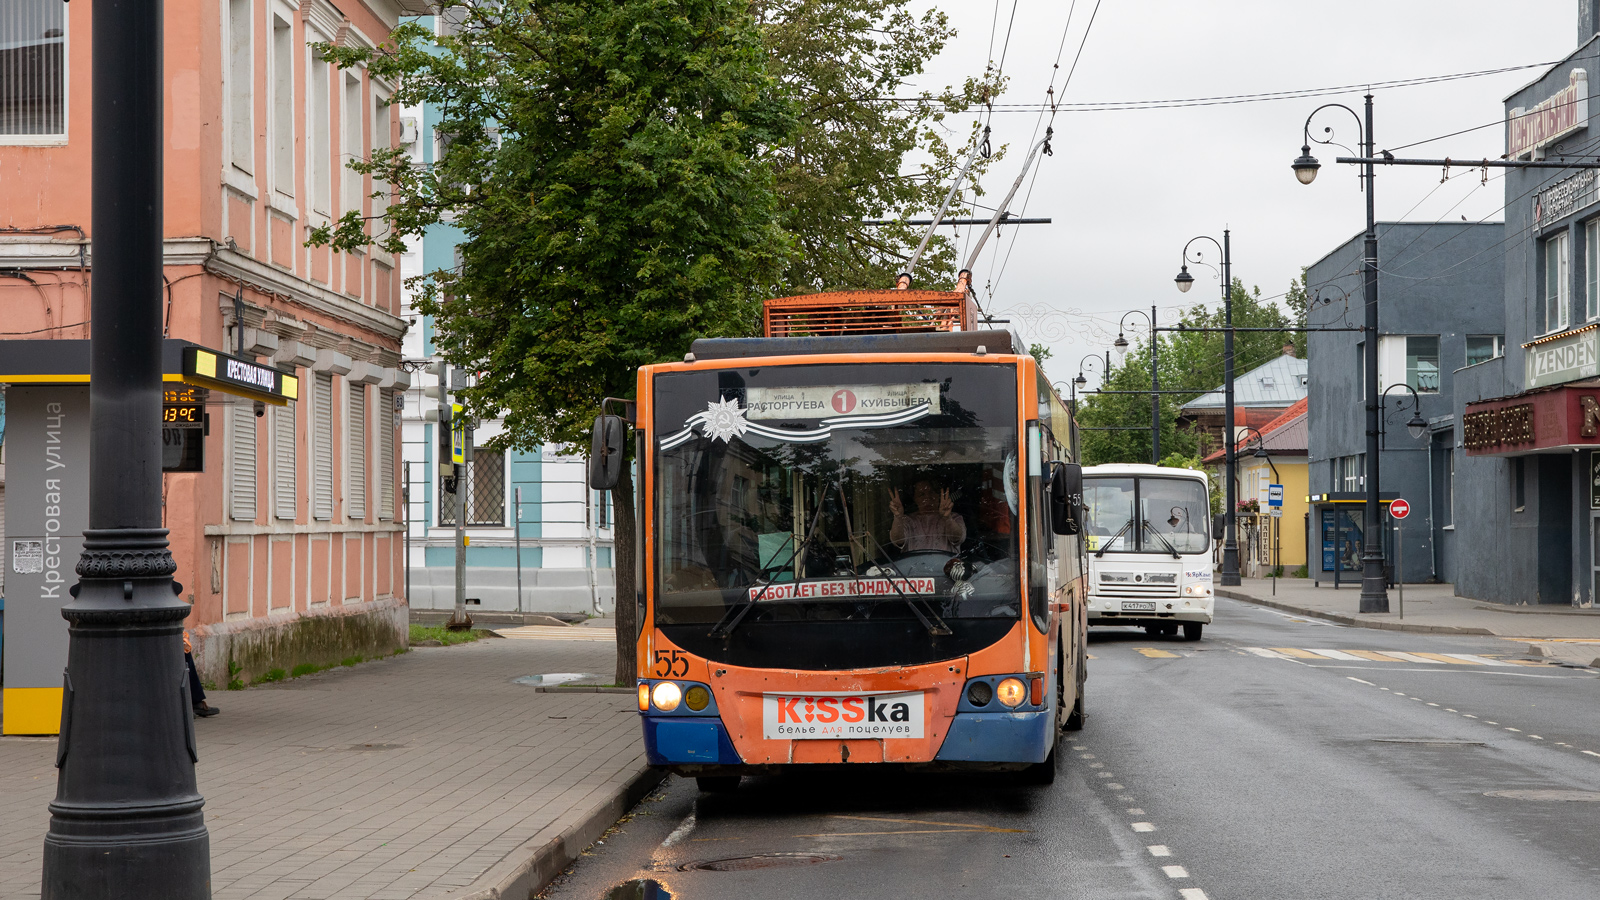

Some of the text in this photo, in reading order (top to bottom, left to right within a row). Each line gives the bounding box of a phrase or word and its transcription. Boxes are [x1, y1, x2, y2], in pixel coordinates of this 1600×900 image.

[1538, 340, 1596, 375] ZENDEN
[227, 359, 275, 392] КРЕСТОВАЯ УЛИЦА
[747, 401, 825, 411] РАСТОРГУЕВА
[837, 391, 848, 412] 1
[861, 397, 933, 408] КУЙБЫШЕВА
[40, 402, 65, 599] Крестовая улица
[750, 580, 934, 601] РАБОТАЕТ БЕЗ КОНДУКТОРА
[655, 650, 689, 678] 55
[778, 725, 910, 736] белье для поцелуев
